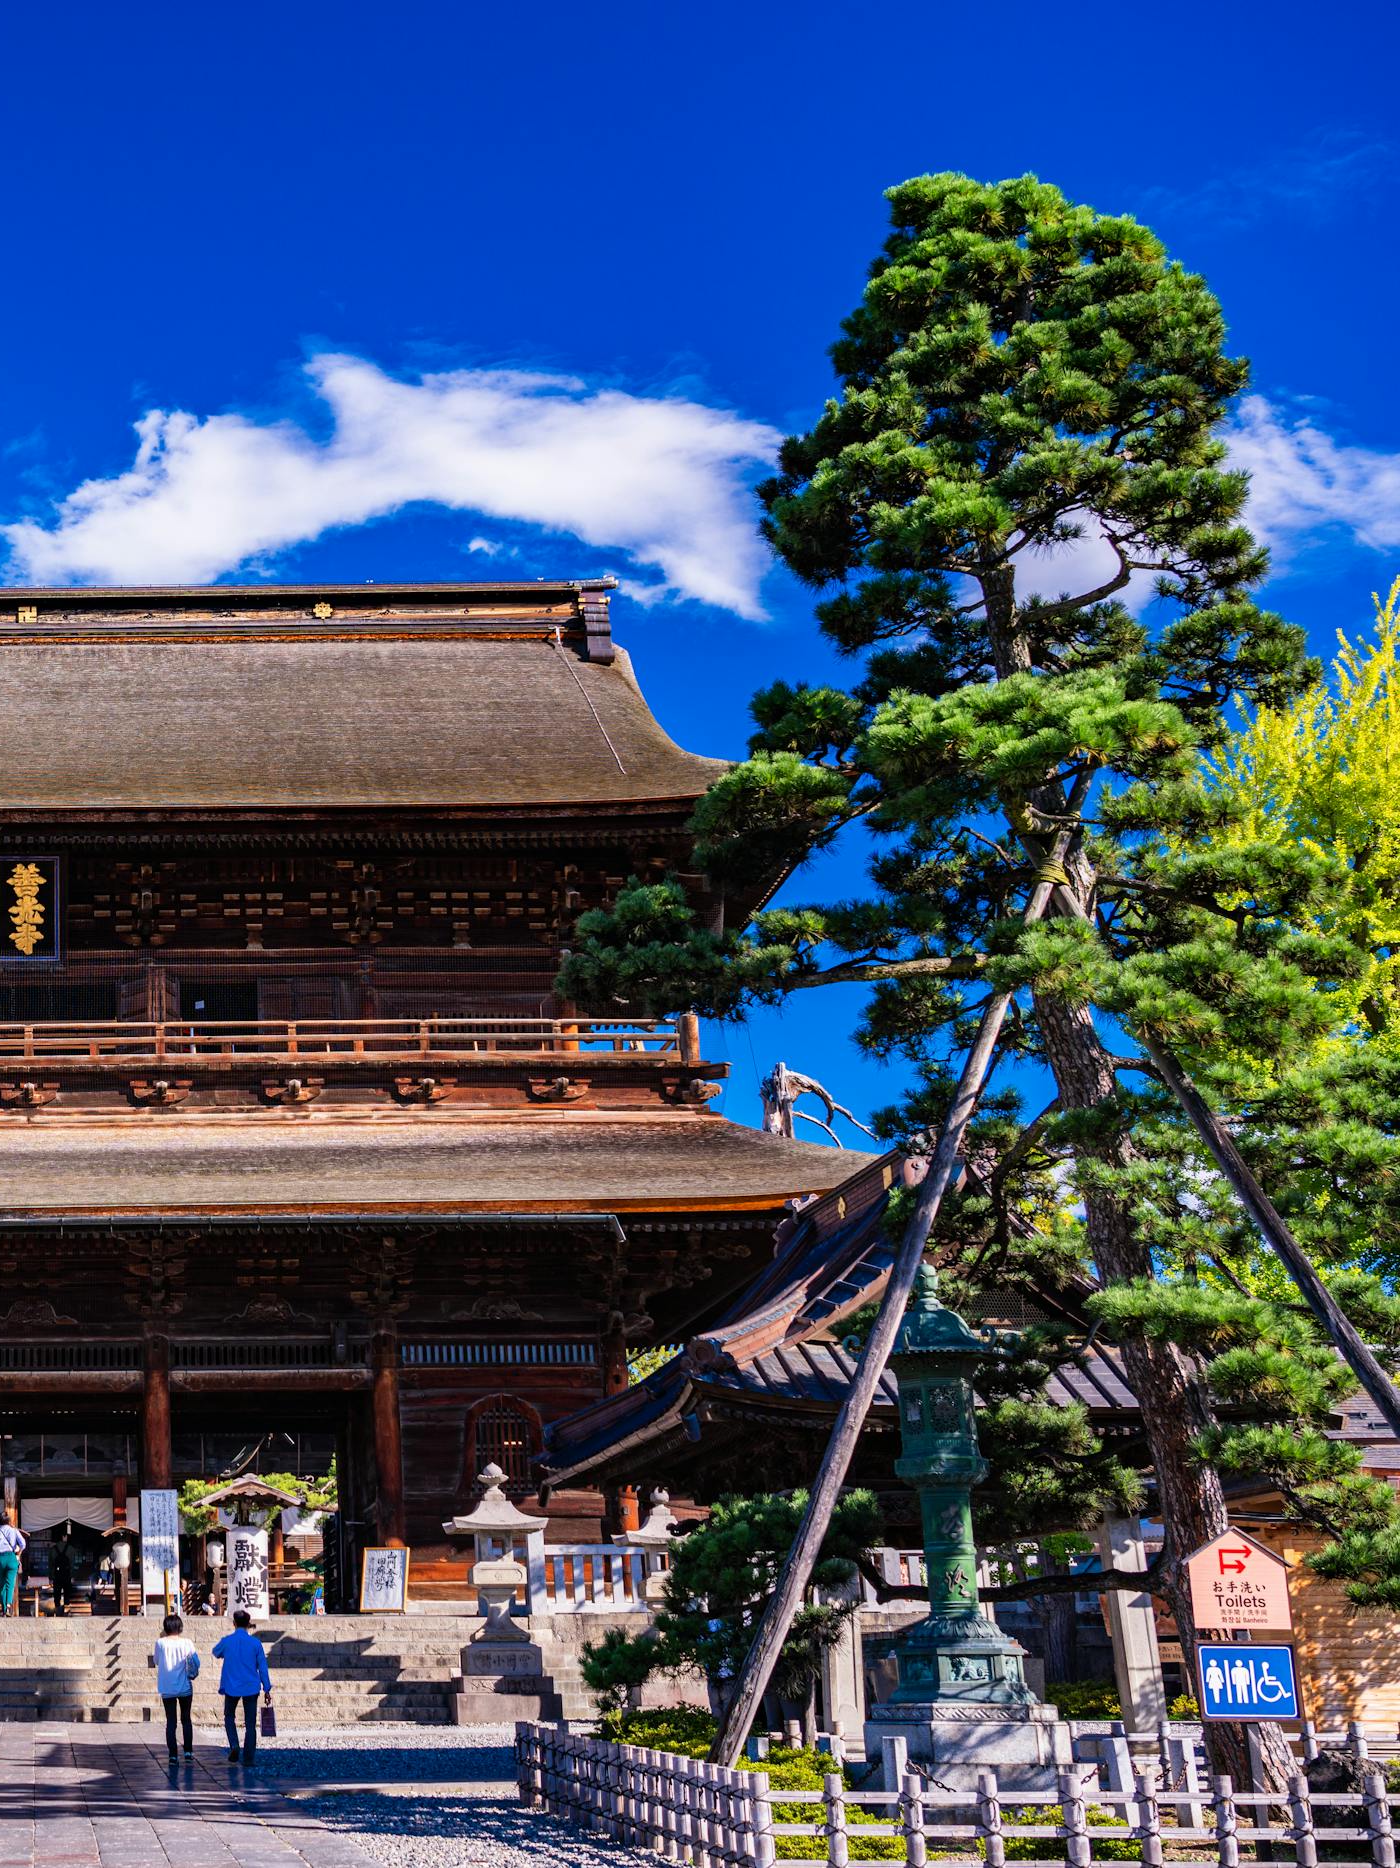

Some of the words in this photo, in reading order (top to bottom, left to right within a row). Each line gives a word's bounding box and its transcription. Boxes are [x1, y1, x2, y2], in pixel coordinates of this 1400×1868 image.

[6, 862, 47, 955] 善光寺
[1212, 1581, 1266, 1594] お手洗い
[1215, 1594, 1266, 1608] Toilets
